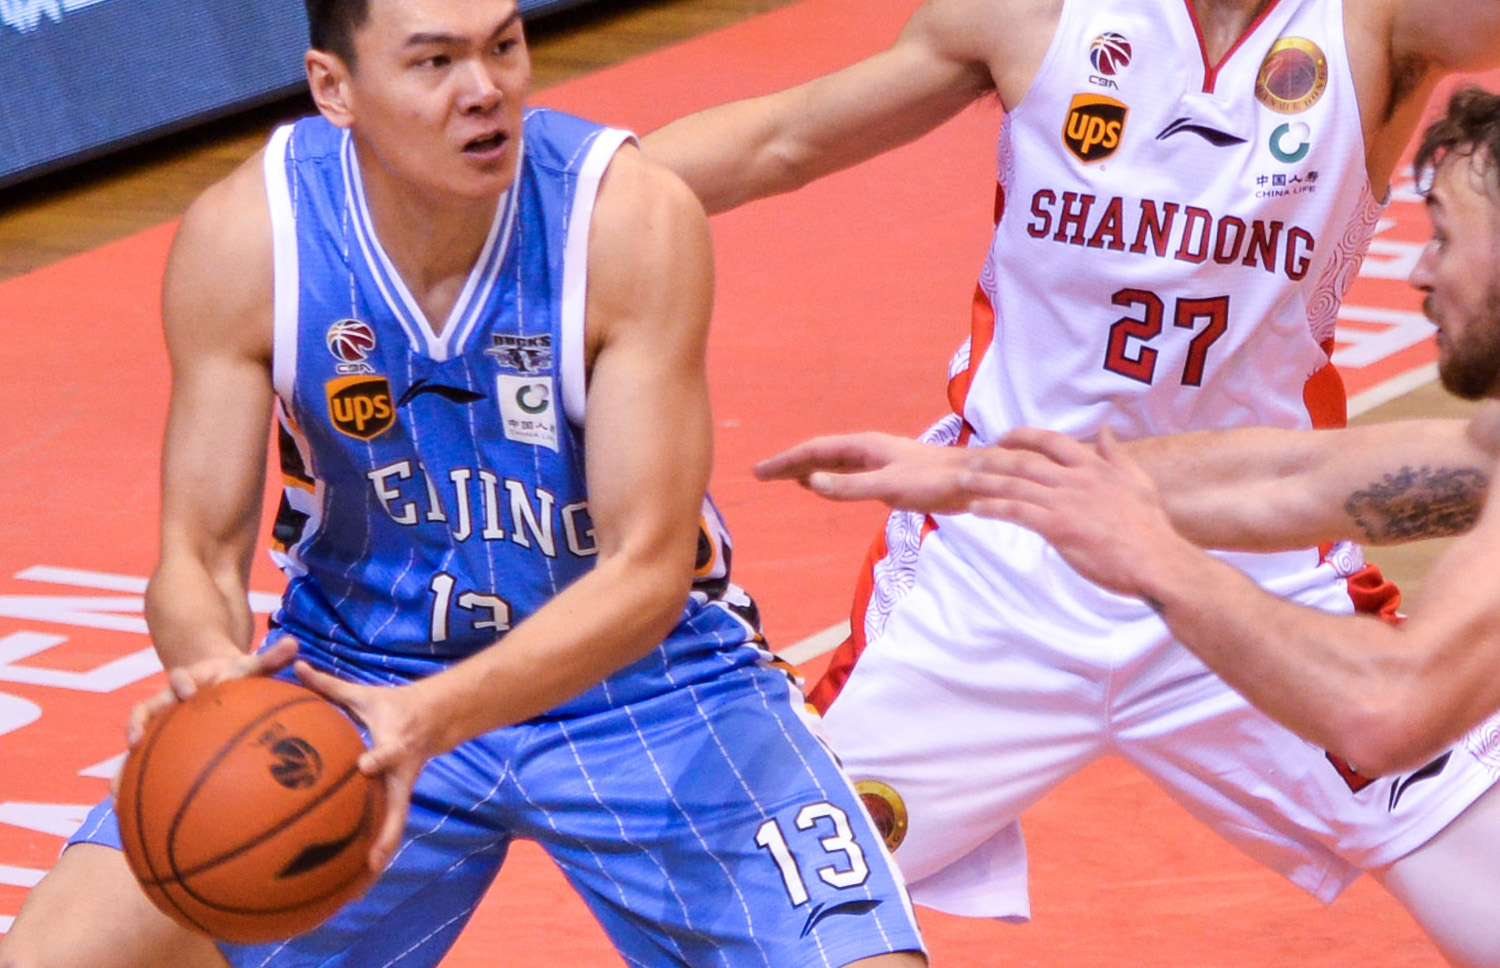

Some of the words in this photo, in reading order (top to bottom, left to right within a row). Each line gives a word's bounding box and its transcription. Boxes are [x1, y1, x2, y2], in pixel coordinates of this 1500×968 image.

[1088, 74, 1119, 91] CBA
[1067, 111, 1121, 154] ups
[1255, 189, 1290, 199] CHINA
[1293, 185, 1316, 195] LIFE
[1256, 171, 1318, 188] 中国人寿
[1026, 187, 1316, 282] SHANDONG
[1102, 288, 1230, 388] 27
[333, 395, 391, 431] ups
[367, 460, 598, 559] EIJING
[753, 800, 871, 908] 13
